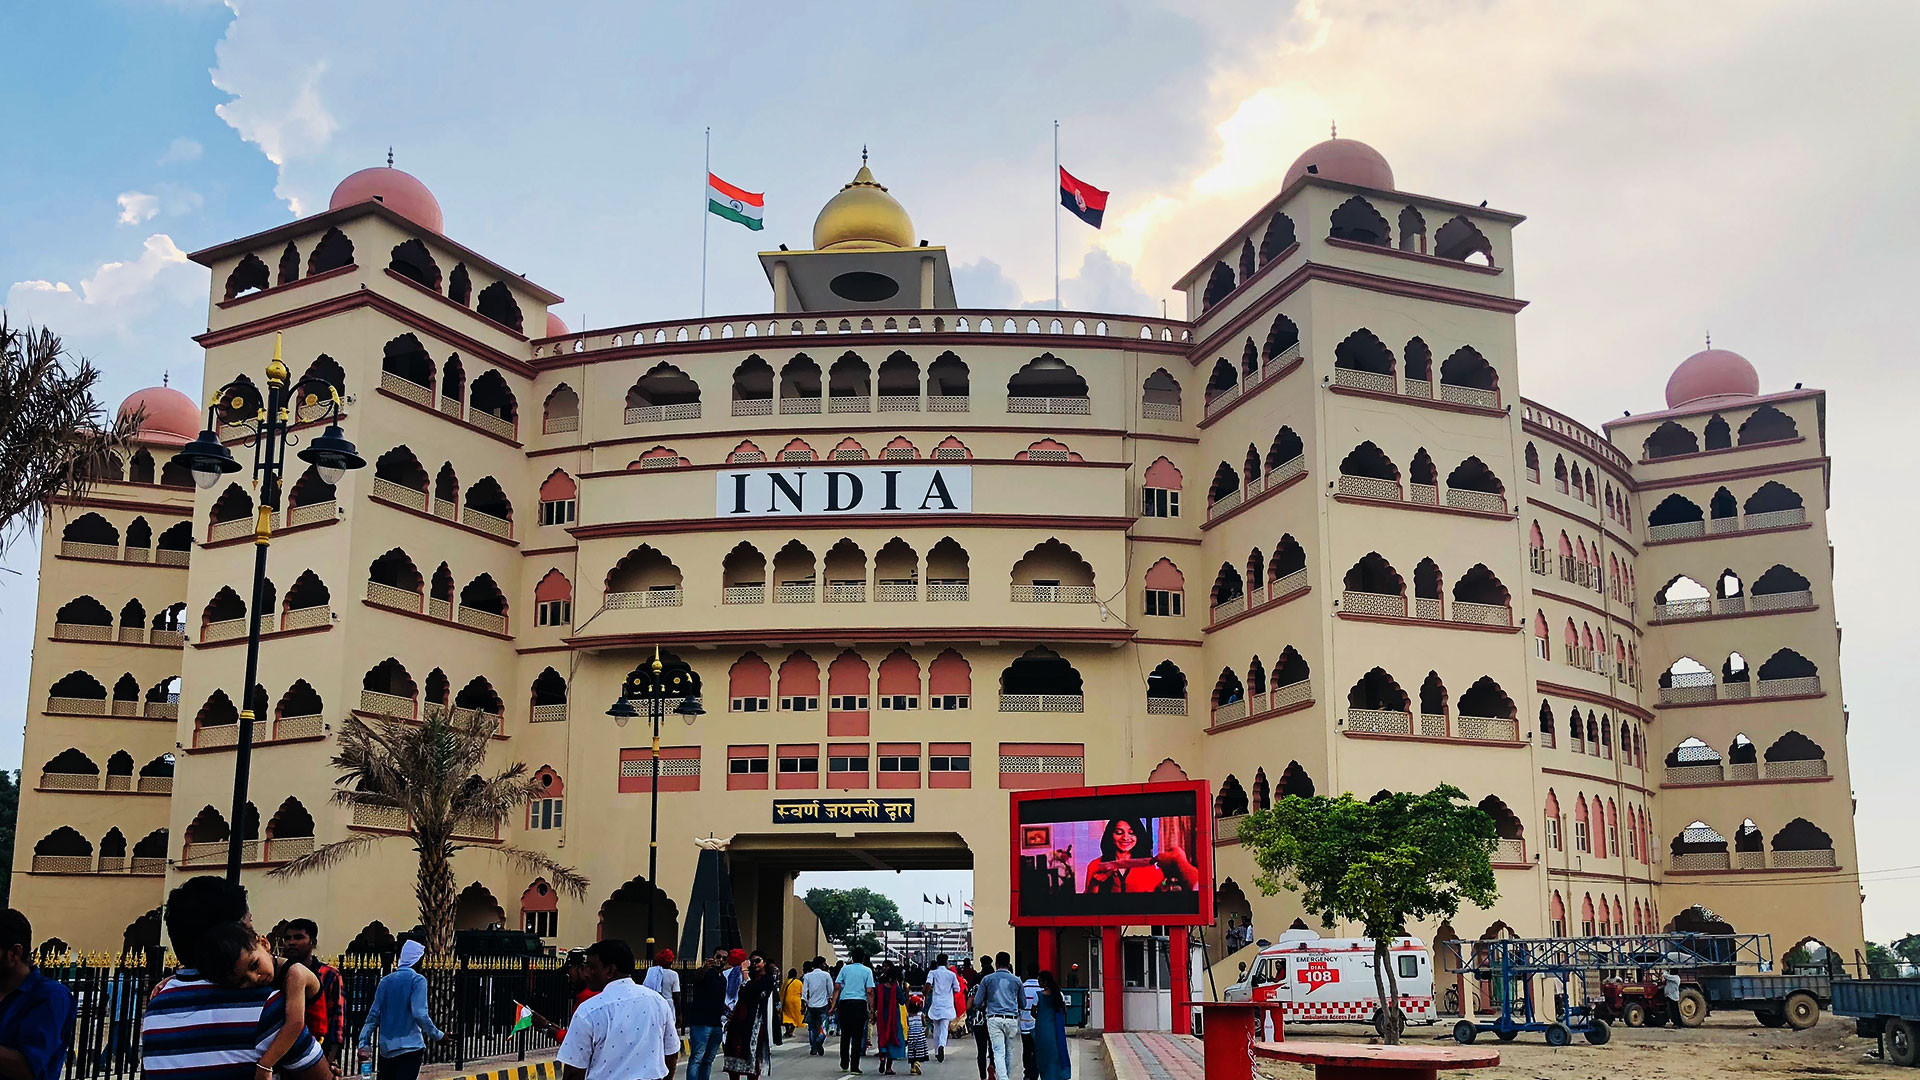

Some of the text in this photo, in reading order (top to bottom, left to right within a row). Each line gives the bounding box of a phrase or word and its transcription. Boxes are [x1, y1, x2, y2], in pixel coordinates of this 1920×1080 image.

[730, 469, 958, 513] INDIA
[775, 799, 912, 821] स्वर्ण जयन्ती द्वार
[1305, 971, 1332, 982] 108
